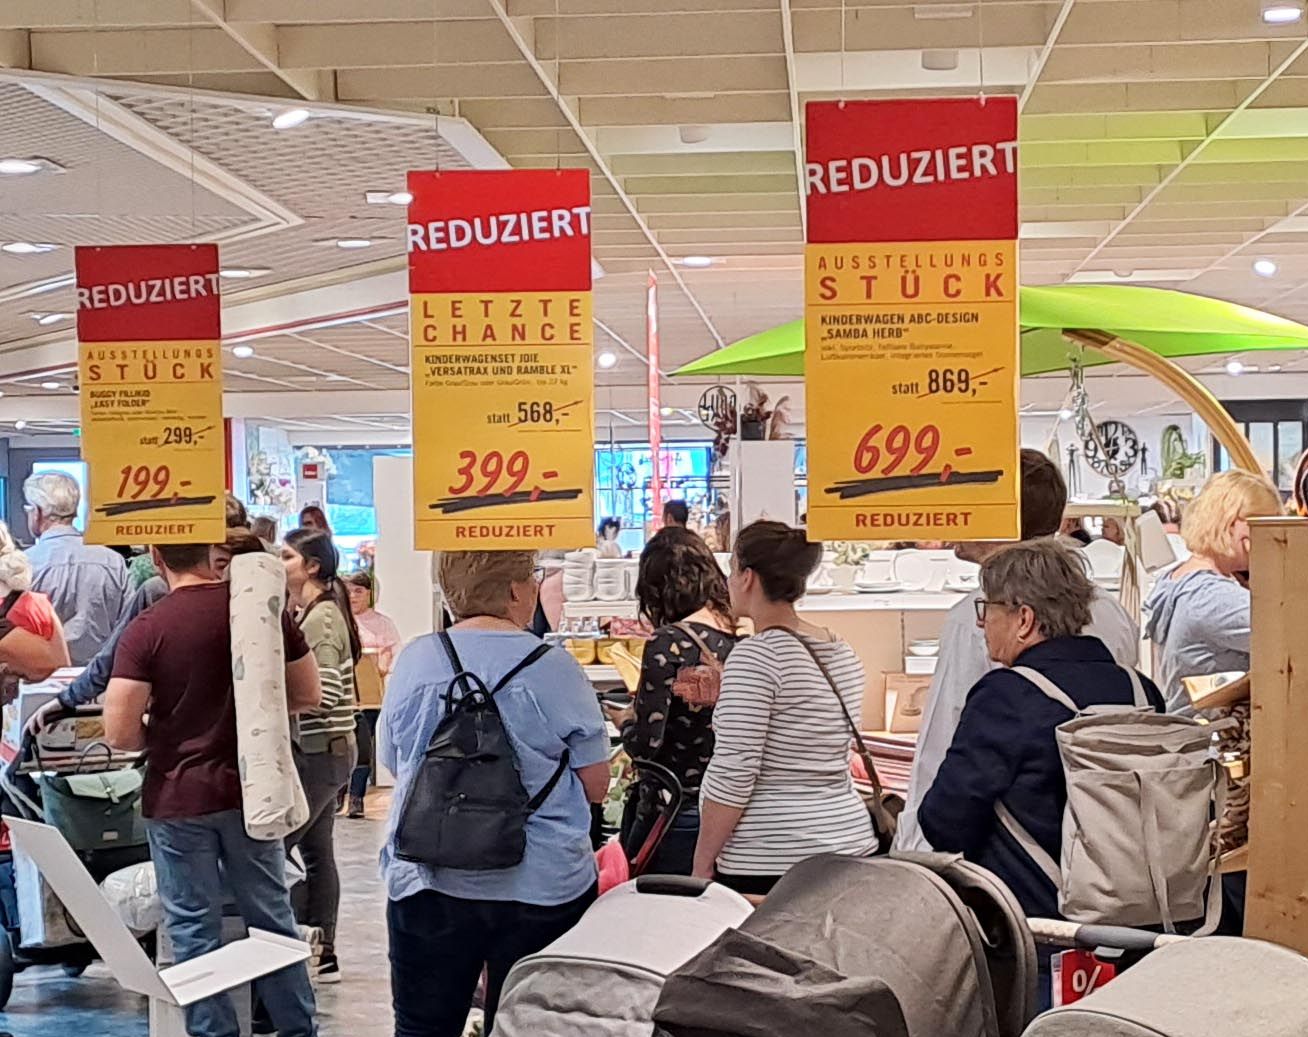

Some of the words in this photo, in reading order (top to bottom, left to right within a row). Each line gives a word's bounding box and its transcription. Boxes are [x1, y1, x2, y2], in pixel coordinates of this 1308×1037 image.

[806, 141, 1018, 195] REDUZIERT
[408, 207, 591, 252] REDUZIERT
[818, 252, 1004, 271] AUSSTELLUNGS
[76, 273, 220, 310] REDUZIERT
[819, 269, 1004, 300] STÜCK
[423, 299, 582, 319] LETZTE
[821, 313, 905, 326] KINDERWAGEN
[909, 312, 979, 324] ABC-DESIGN
[423, 322, 582, 343] CHANCE
[86, 348, 213, 361] AUSSTELLUNGS
[425, 353, 516, 365] KINDERWAGENSET
[519, 353, 539, 364] JOIE
[88, 359, 214, 381] STÜCK
[492, 366, 512, 376] UND
[516, 365, 556, 375] RAMBLE
[892, 382, 920, 395] statt
[928, 369, 988, 396] 869,-
[487, 413, 511, 424] statt
[518, 401, 570, 426] 568,-
[854, 424, 973, 482] 699,-
[116, 465, 192, 503] 199,-
[448, 450, 559, 501] 399,-
[115, 523, 195, 536] REDUZIERT
[855, 512, 972, 528] REDUZIERT
[455, 524, 556, 539] REDUZIERT
